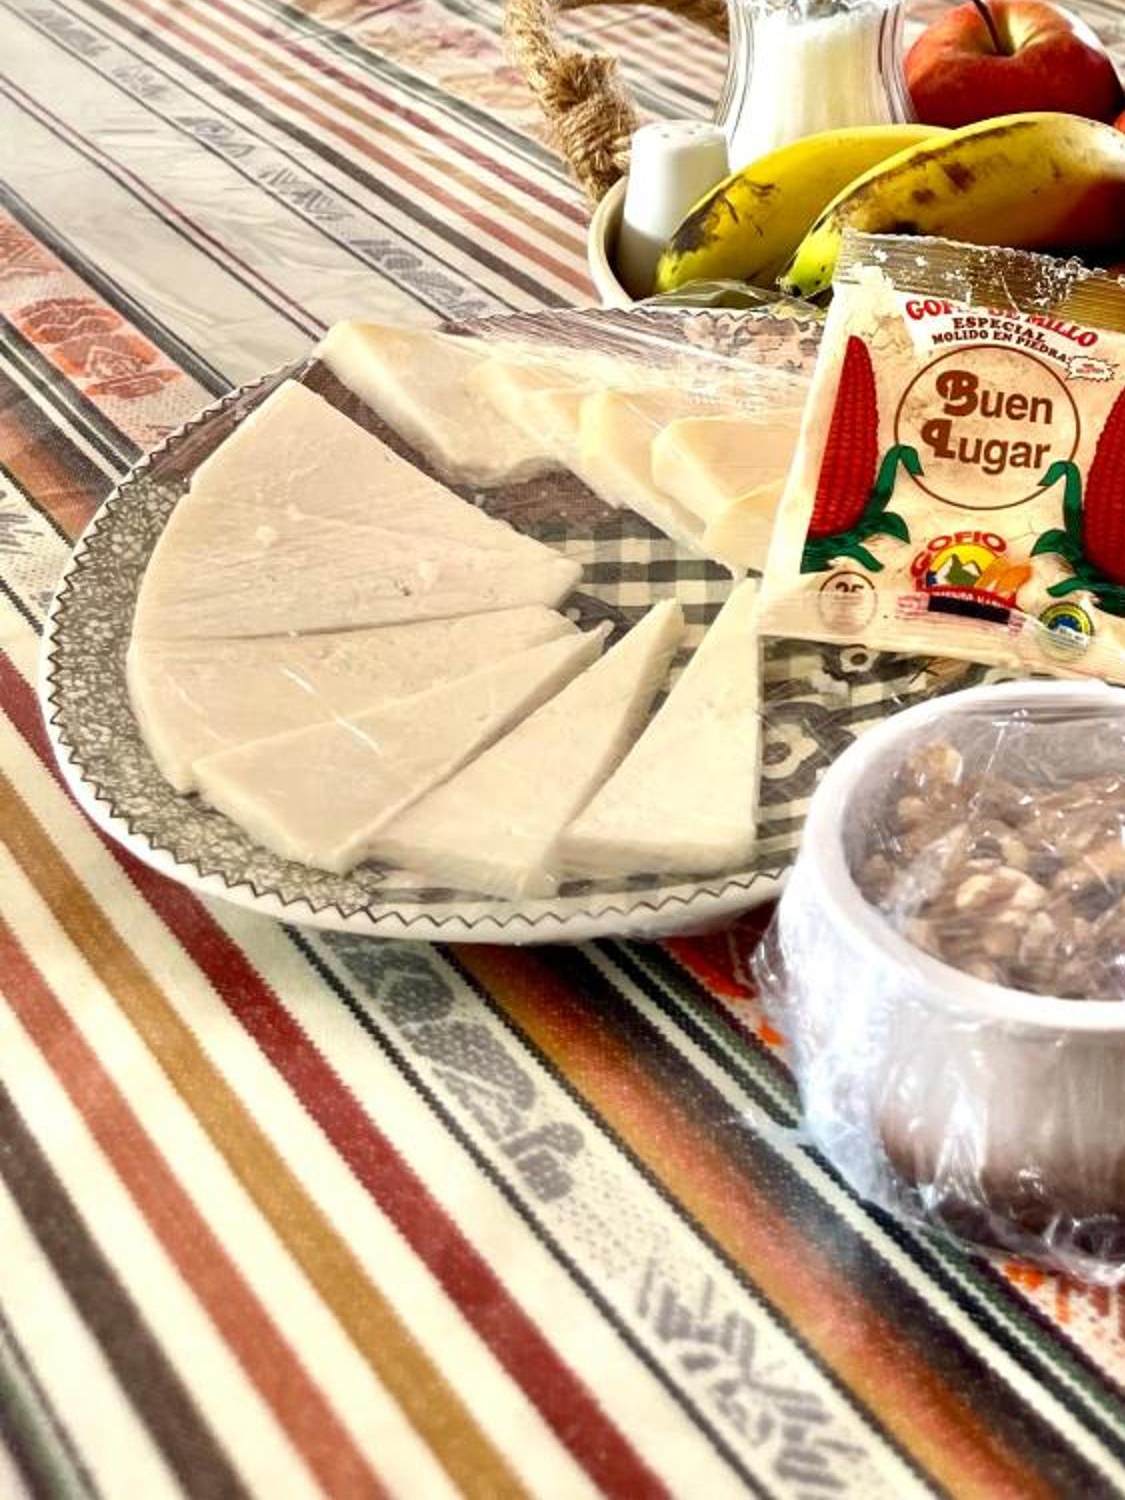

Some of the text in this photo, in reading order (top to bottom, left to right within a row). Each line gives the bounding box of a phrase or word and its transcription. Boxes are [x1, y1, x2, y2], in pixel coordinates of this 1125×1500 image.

[931, 330, 989, 345] MOLIDO
[993, 331, 1014, 342] EN
[952, 317, 1046, 342] ESPECIAL
[935, 370, 1054, 424] Buen
[921, 419, 1052, 476] Lugar
[910, 531, 1007, 578] GOFIO
